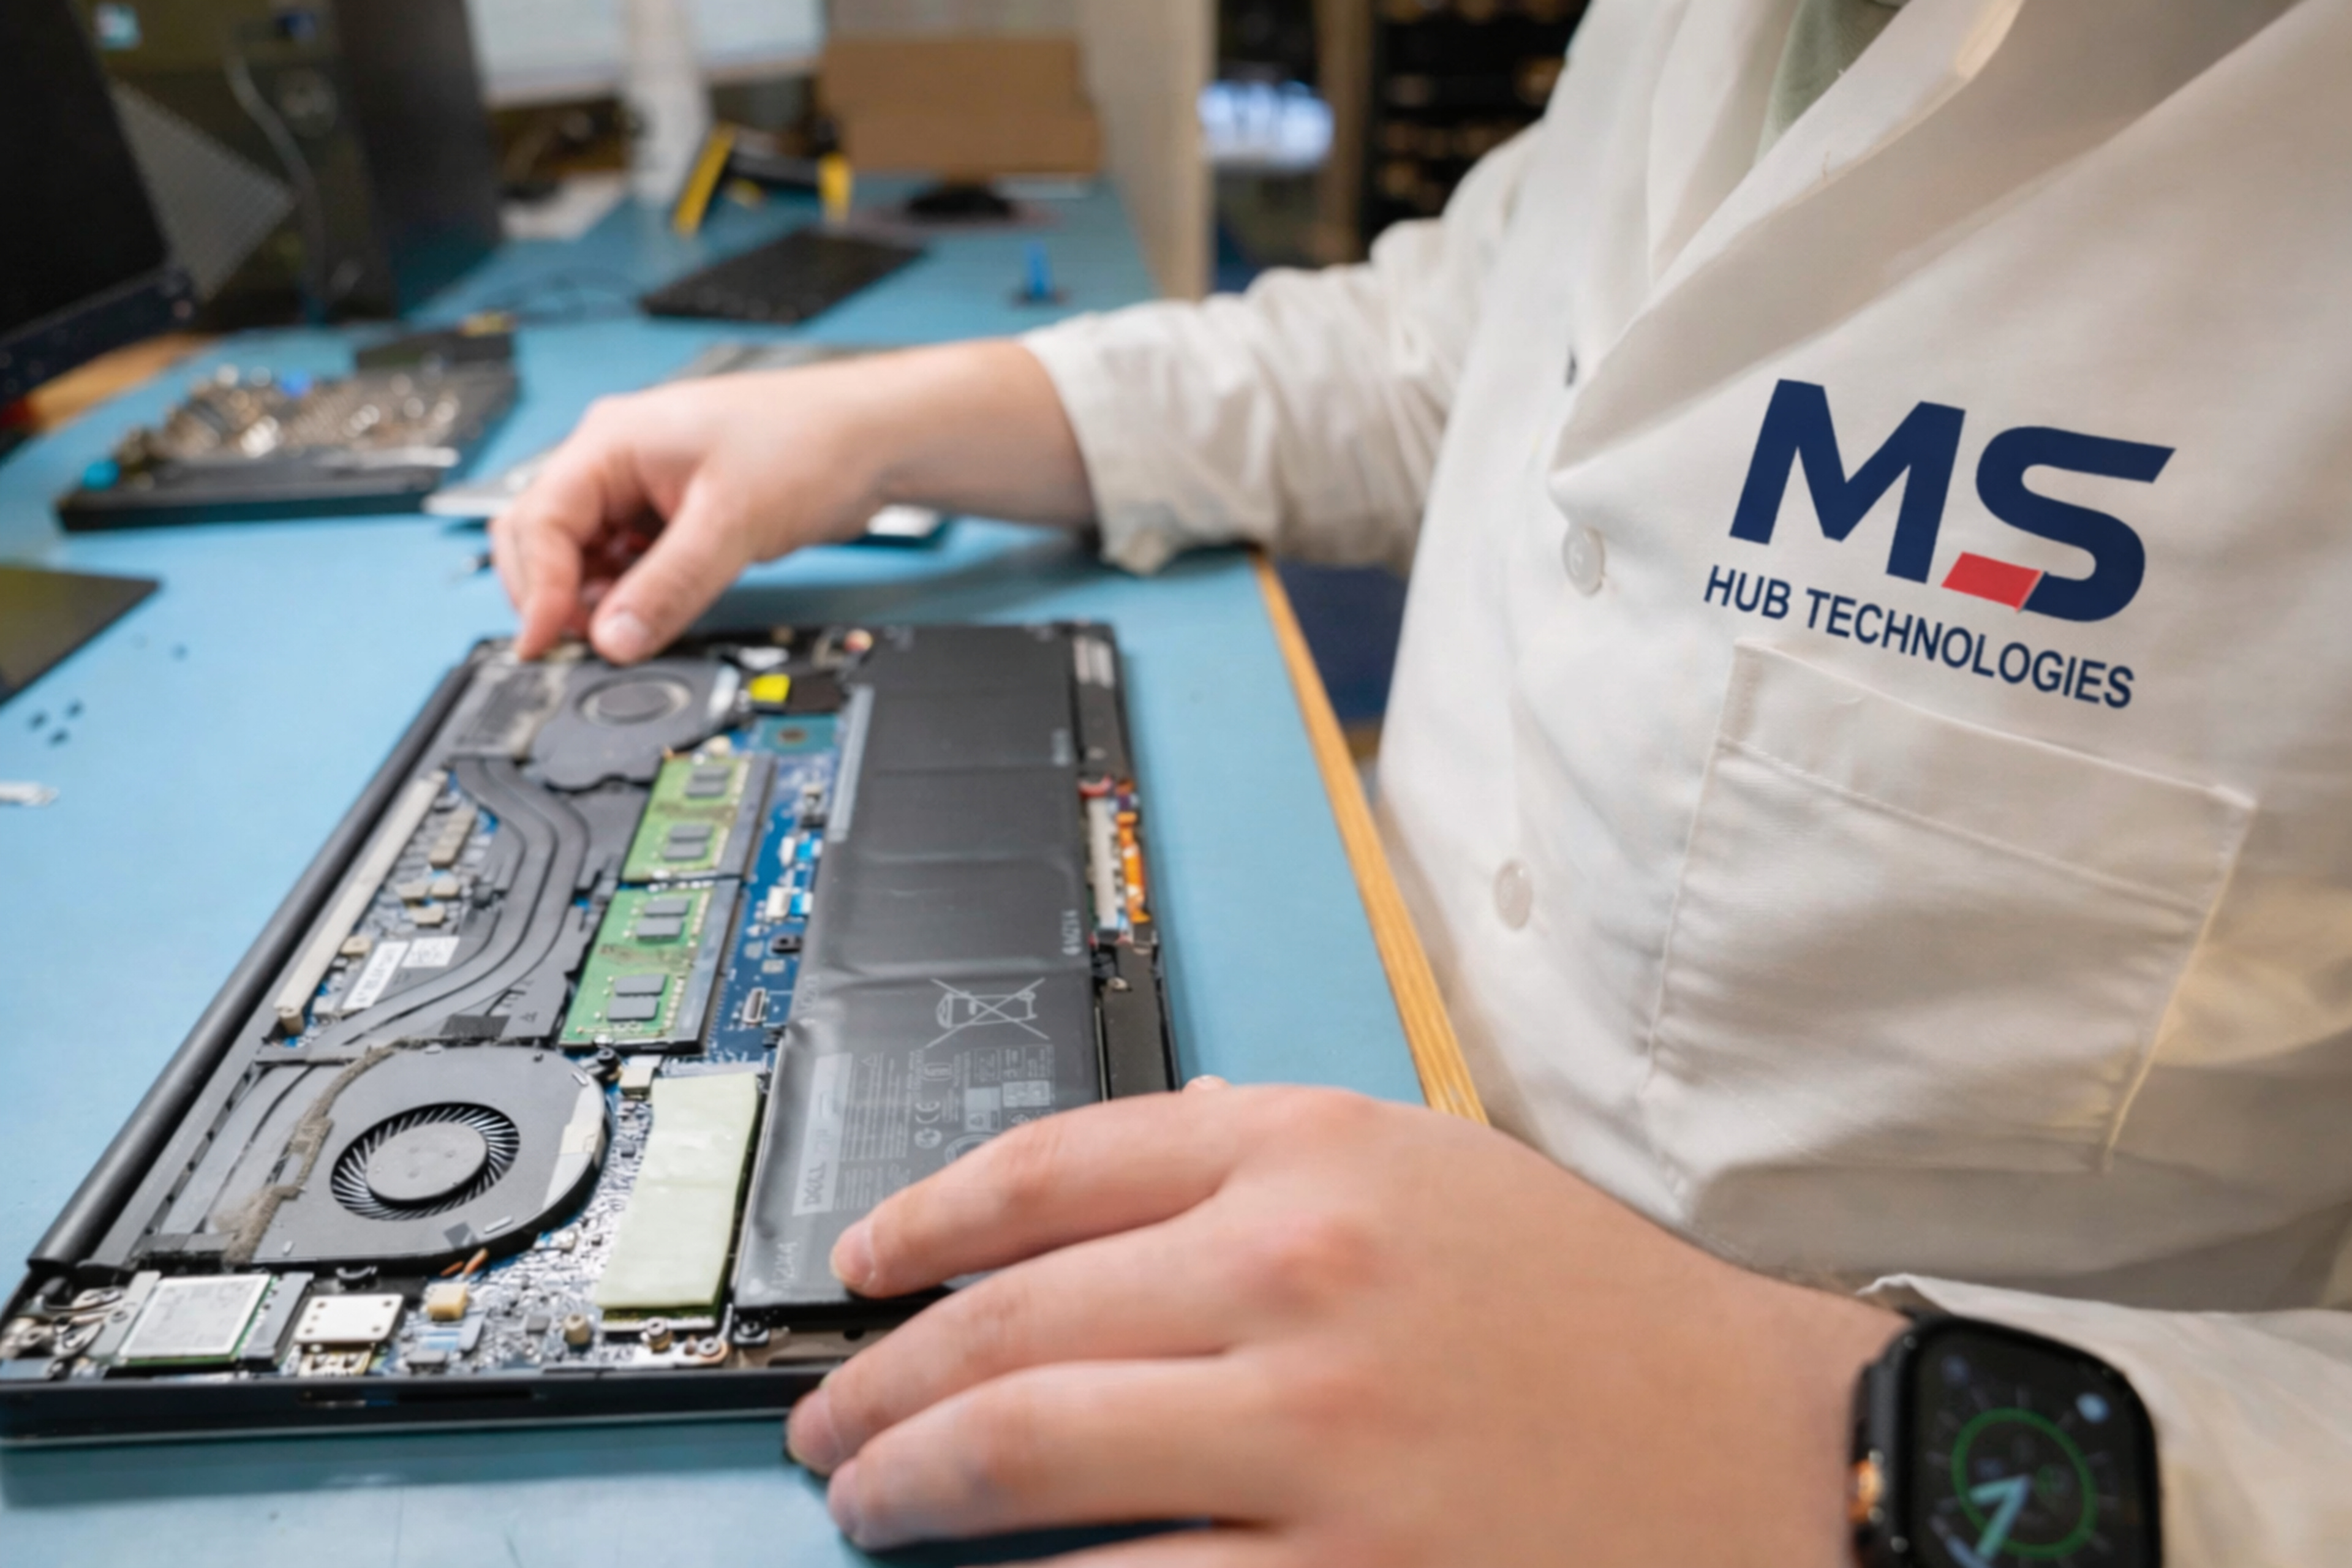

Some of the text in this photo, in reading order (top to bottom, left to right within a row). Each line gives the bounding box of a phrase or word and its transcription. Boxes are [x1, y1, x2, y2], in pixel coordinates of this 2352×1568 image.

[1729, 379, 2176, 623] MS
[1704, 565, 2135, 709] HUB TECHNOLOGIES
